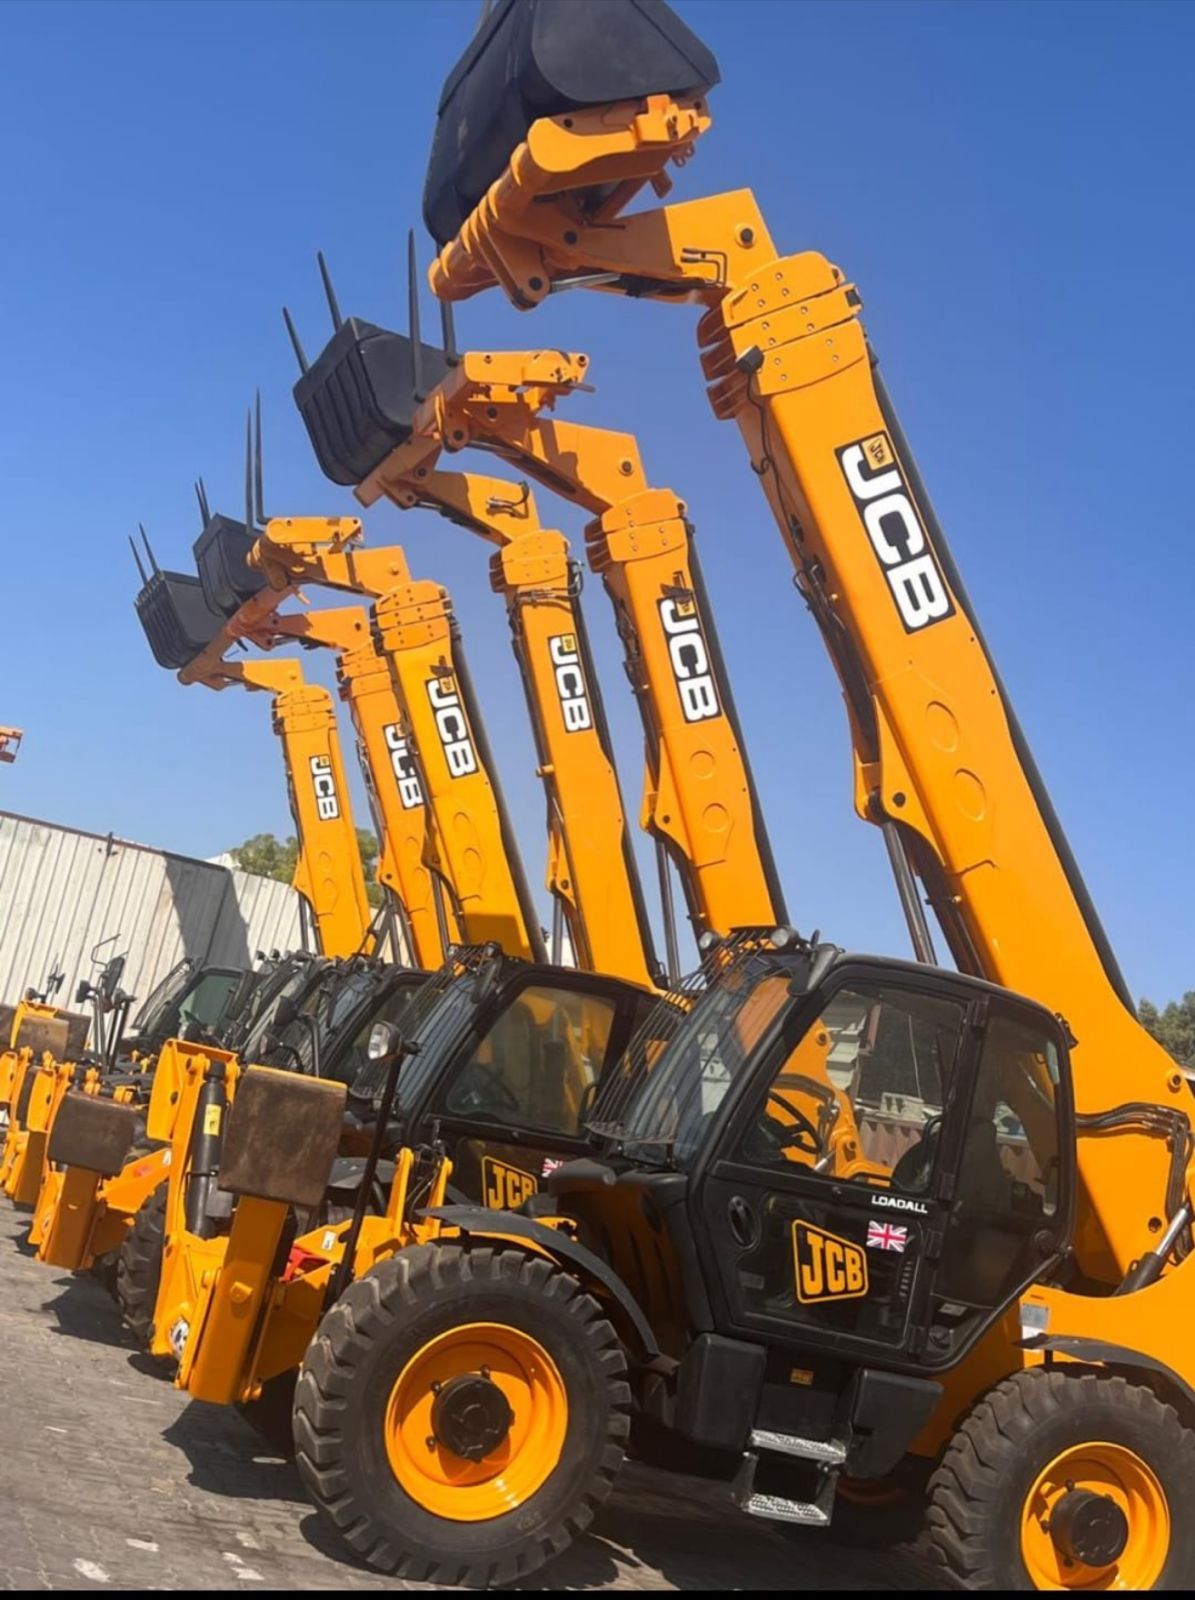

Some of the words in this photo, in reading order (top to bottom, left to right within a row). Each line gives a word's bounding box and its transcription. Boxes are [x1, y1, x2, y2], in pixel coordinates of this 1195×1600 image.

[842, 445, 949, 628] JCB
[550, 637, 591, 732] JCB
[660, 599, 718, 722] JCB
[428, 680, 476, 777] JCB
[310, 757, 338, 820] JCB
[871, 1194, 928, 1214] LOADALL
[802, 1231, 864, 1295] JCB
